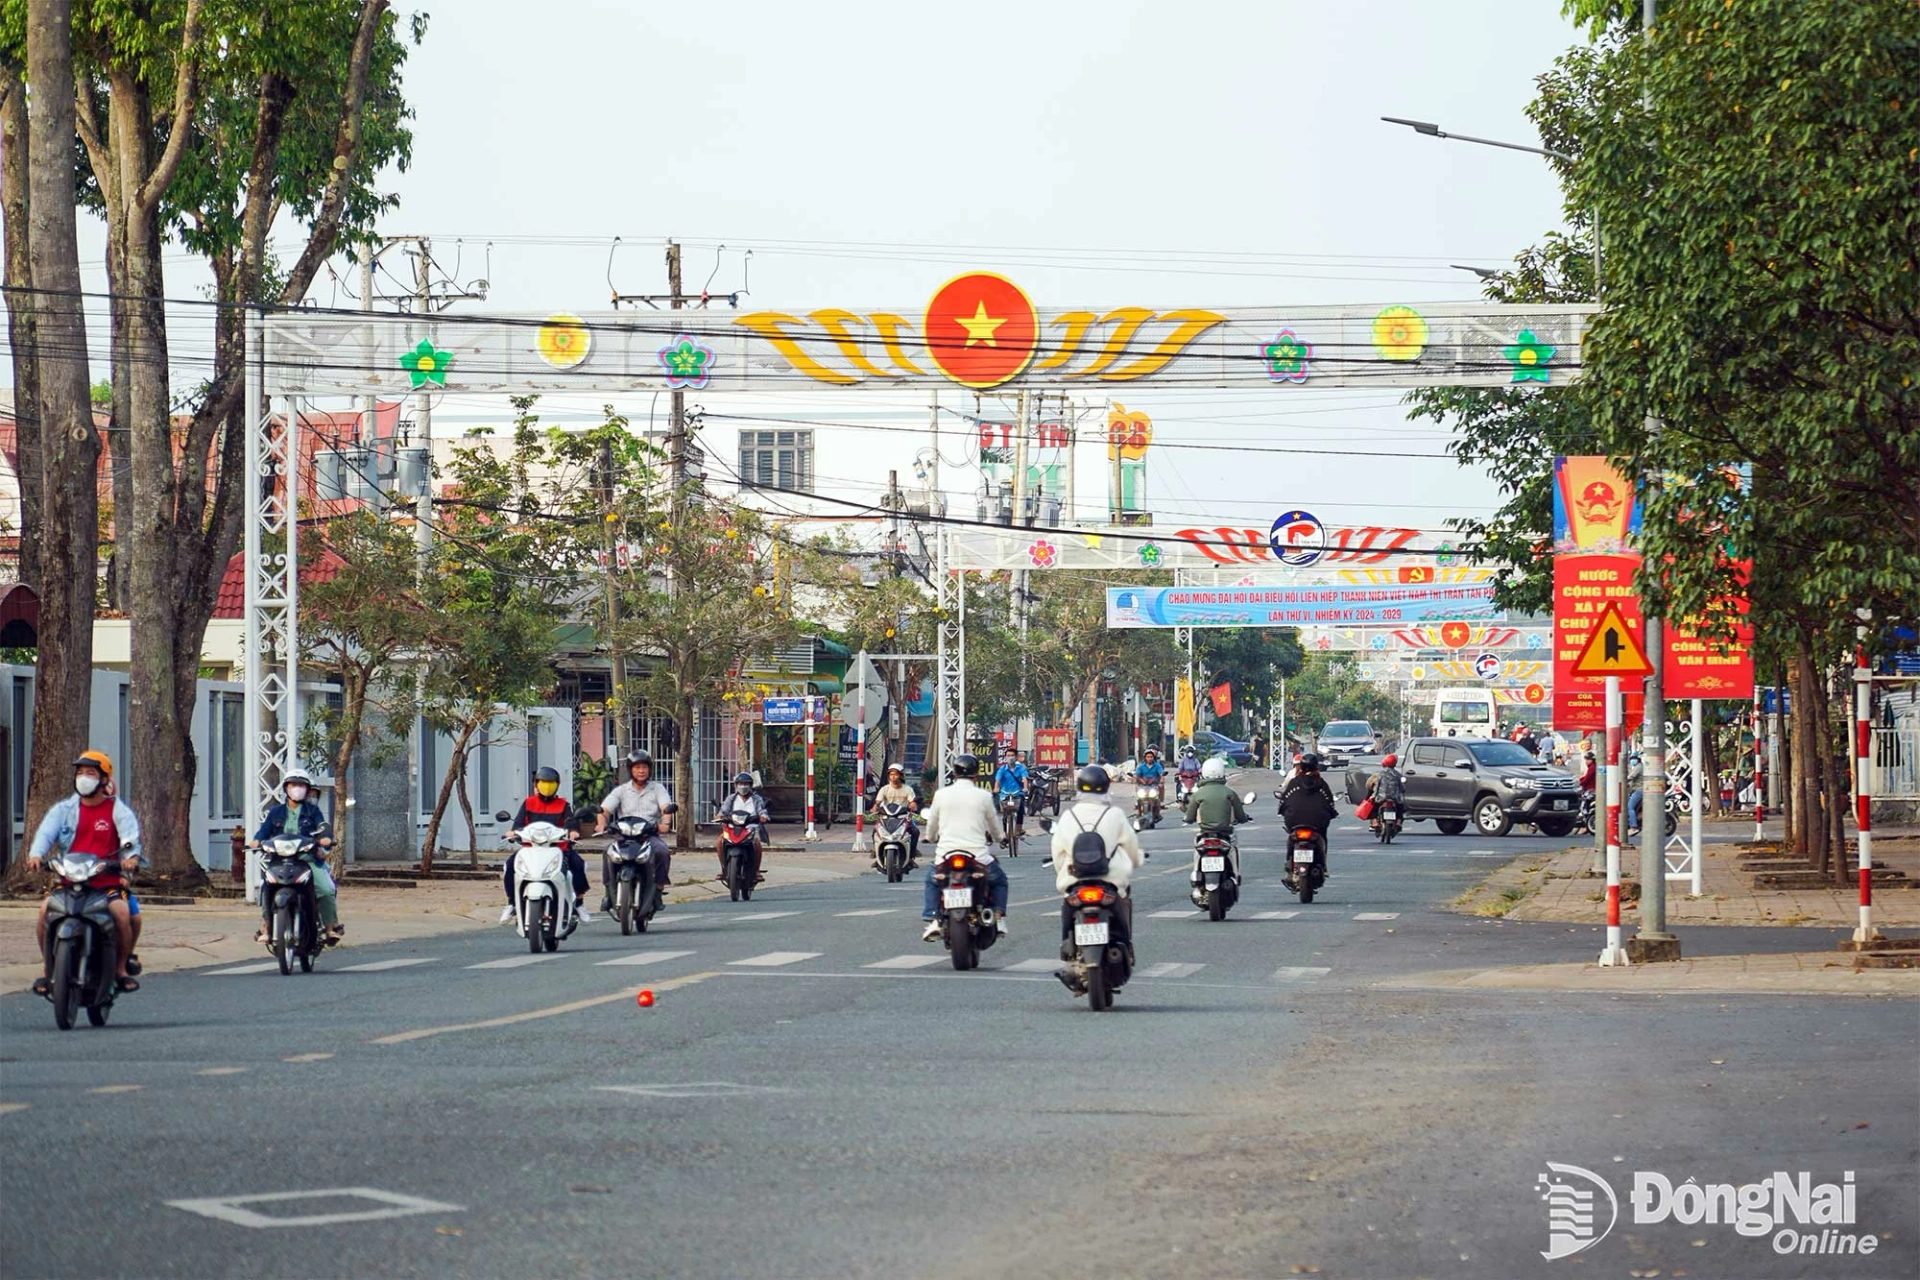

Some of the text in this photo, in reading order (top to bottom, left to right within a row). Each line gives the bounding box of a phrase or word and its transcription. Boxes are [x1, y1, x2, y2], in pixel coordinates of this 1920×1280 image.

[1579, 568, 1618, 582] NƯỚC
[1562, 584, 1602, 598] CỘNG
[1356, 608, 1374, 620] 2024
[1382, 608, 1401, 620] 2029
[1560, 617, 1588, 629] CHỦ
[1565, 632, 1590, 647] VIỆ
[1678, 654, 1740, 665] VĂN MINH
